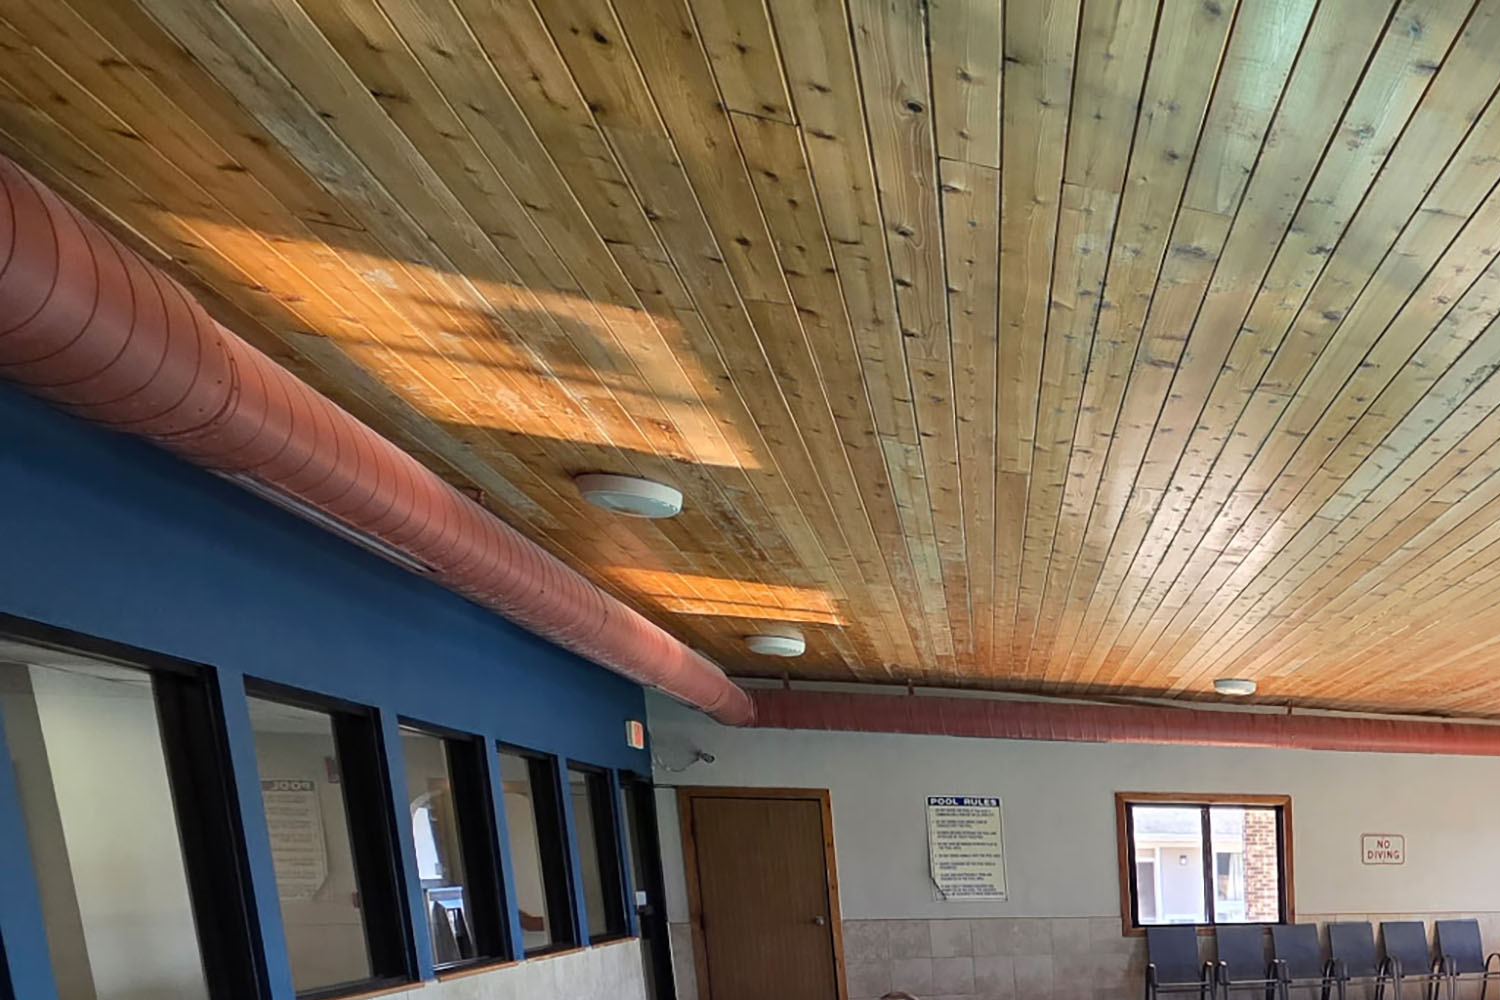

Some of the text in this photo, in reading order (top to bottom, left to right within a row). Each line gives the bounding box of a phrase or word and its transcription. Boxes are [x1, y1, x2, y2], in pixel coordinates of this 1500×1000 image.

[930, 797, 997, 807] POOL RULES
[1376, 839, 1391, 849] NO
[1367, 850, 1400, 860] DIVING
